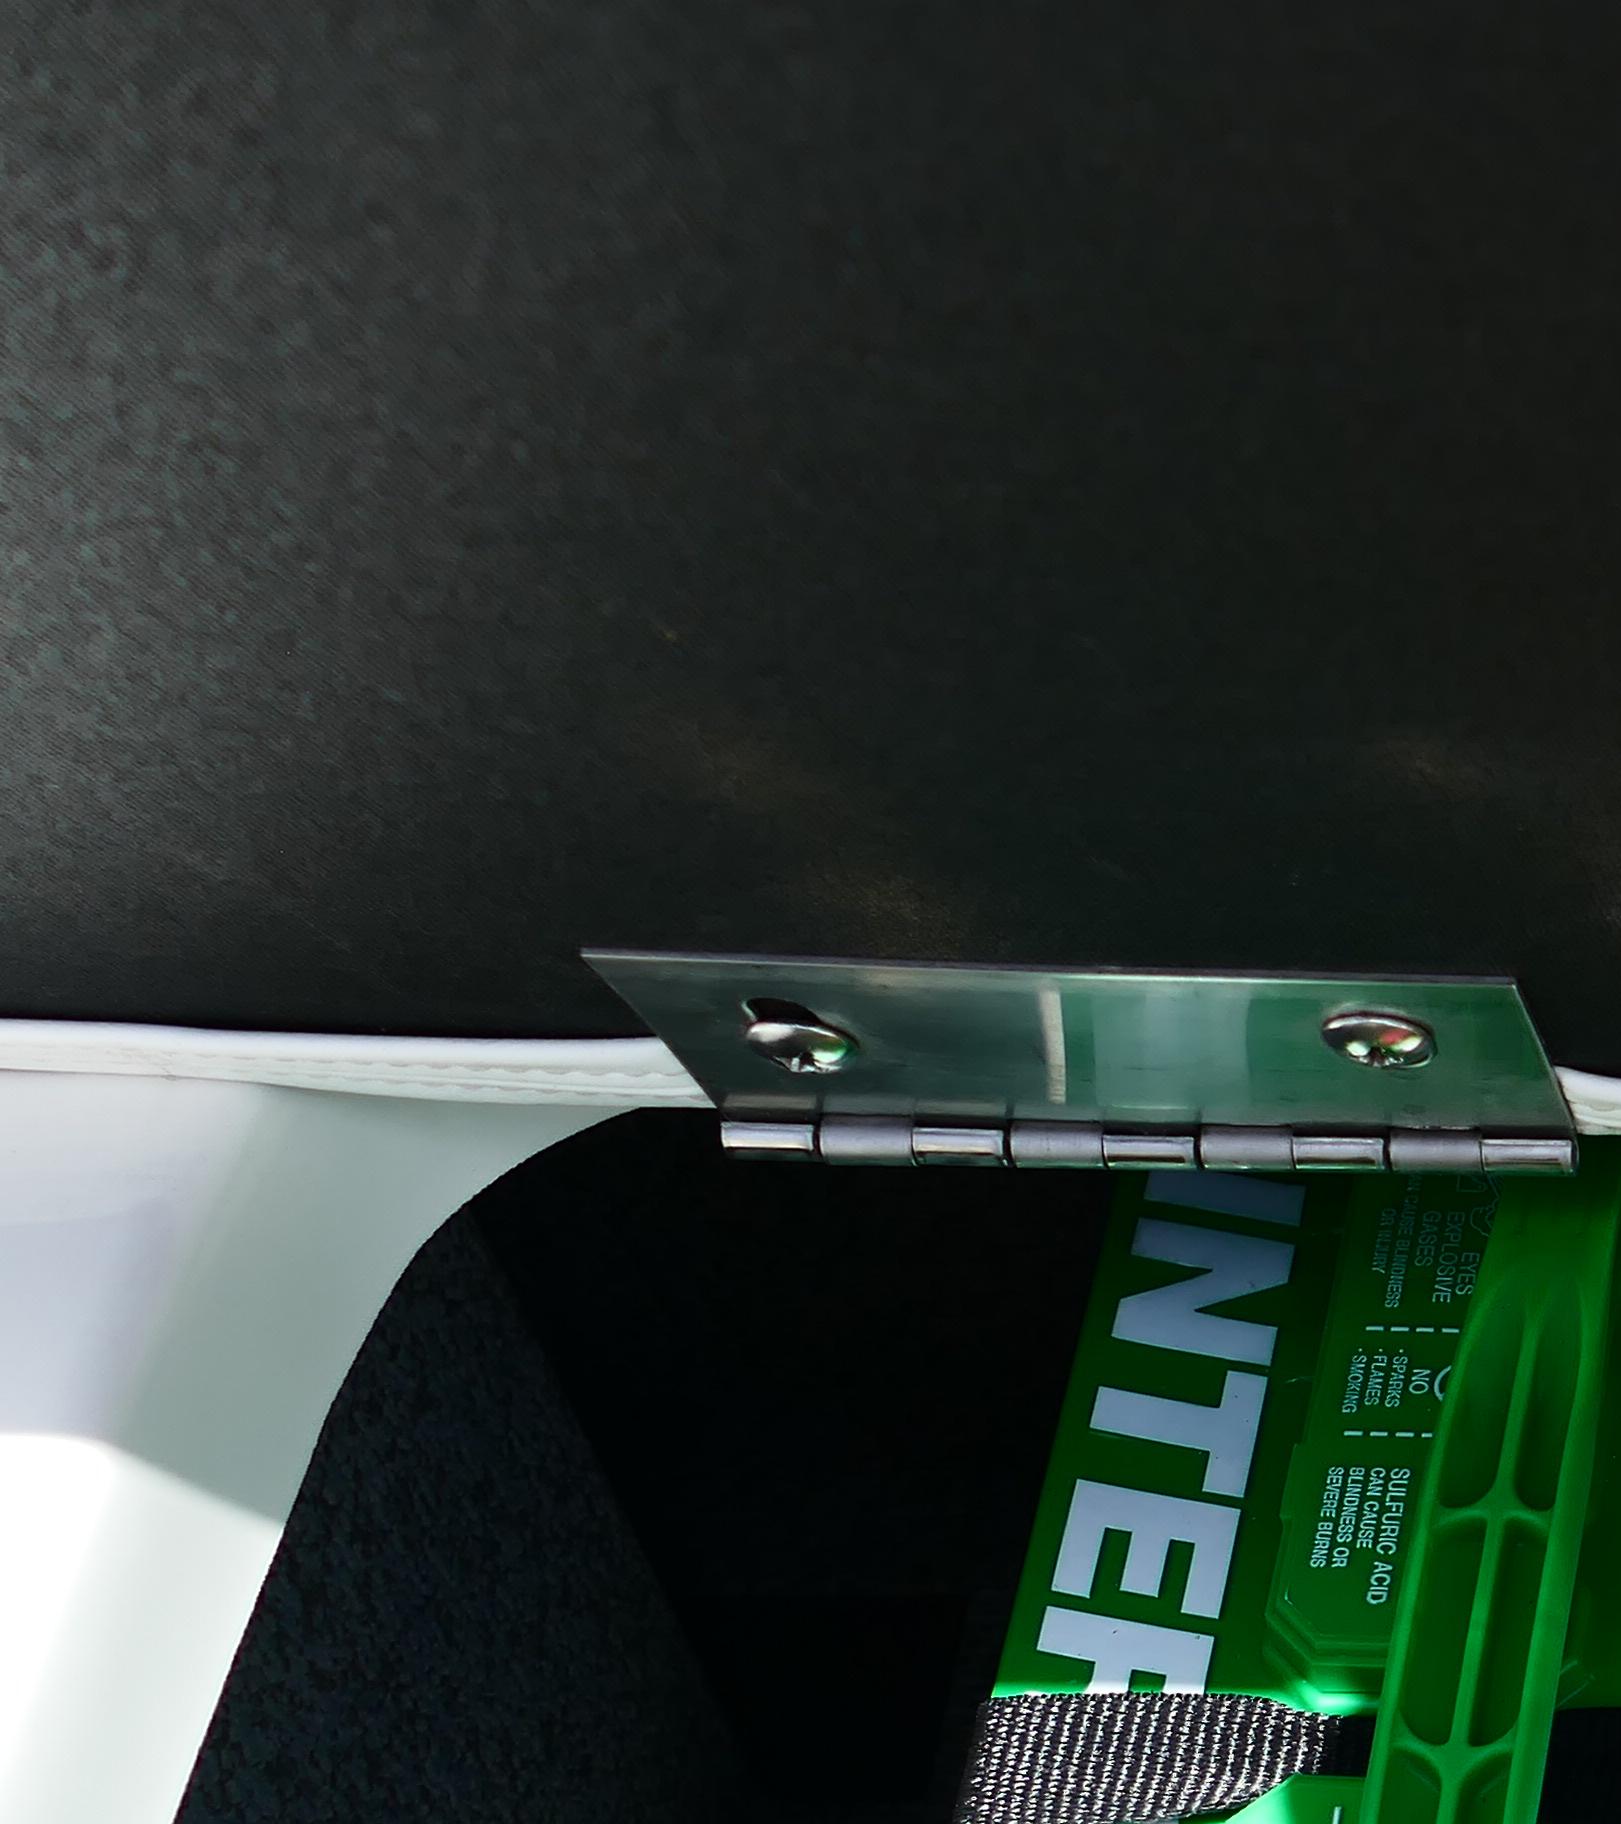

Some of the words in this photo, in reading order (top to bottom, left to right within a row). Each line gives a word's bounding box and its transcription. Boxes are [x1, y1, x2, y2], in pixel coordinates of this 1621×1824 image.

[1372, 1229, 1392, 1274] INJURY
[1414, 1210, 1441, 1267] GASES
[1432, 1212, 1465, 1302] EXPLOSIVE
[1384, 1239, 1410, 1308] BLINDNESS
[1455, 1251, 1480, 1296] EYES
[1342, 1354, 1367, 1413] SMOKING
[1364, 1354, 1387, 1406] FLAMES
[1385, 1355, 1408, 1408] SPARKS
[1409, 1369, 1431, 1395] NO
[1320, 1466, 1345, 1518] SEVERE
[1336, 1466, 1365, 1543] BLINDNESS
[1366, 1467, 1386, 1497] CAN
[1356, 1501, 1379, 1549] CAUSE
[1375, 1467, 1411, 1556] SULFURIC
[1310, 1521, 1333, 1569] BURNS
[1331, 1546, 1350, 1568] OR
[1366, 1561, 1393, 1605] ACID
